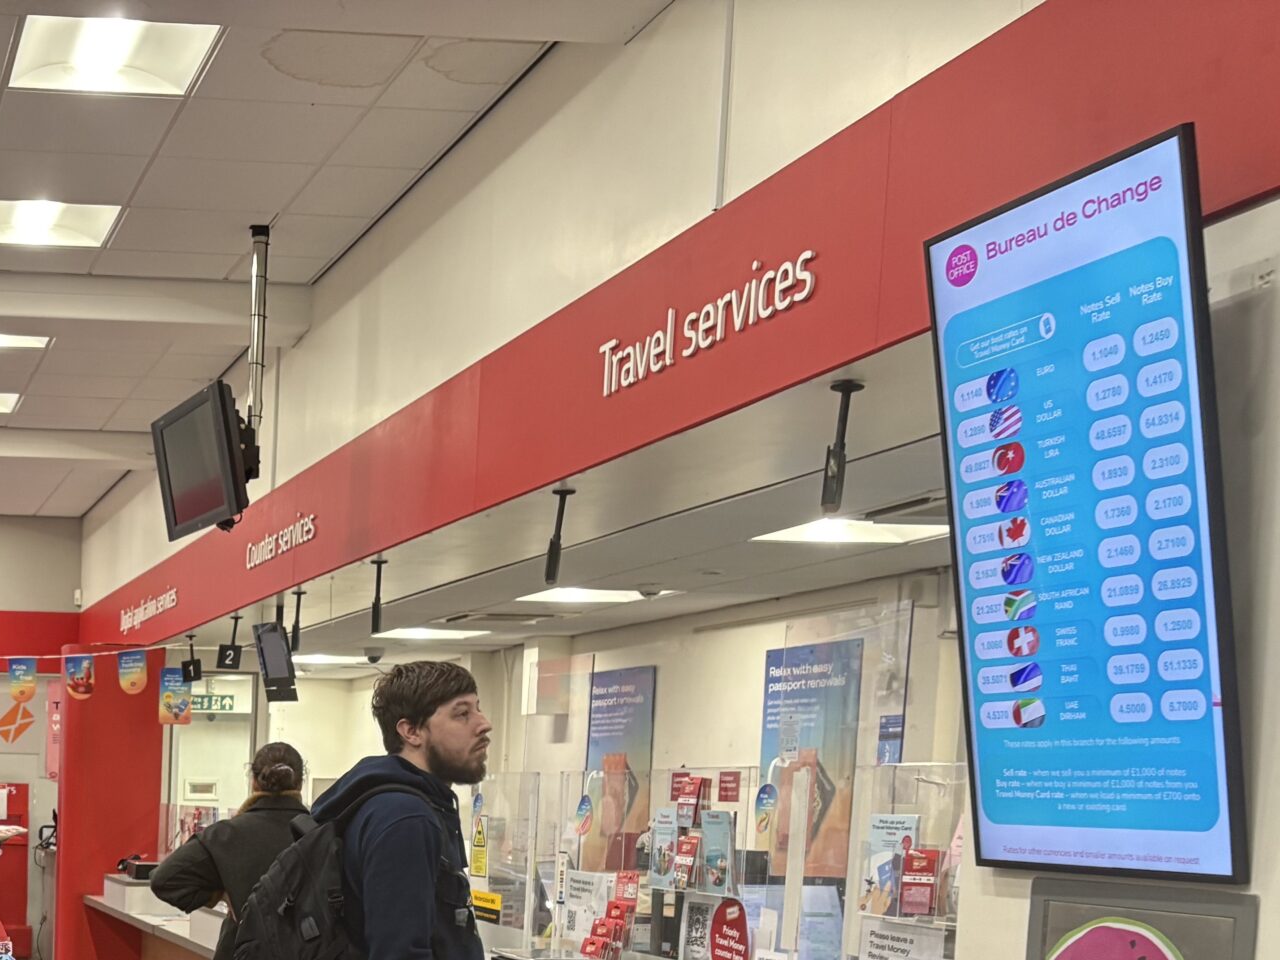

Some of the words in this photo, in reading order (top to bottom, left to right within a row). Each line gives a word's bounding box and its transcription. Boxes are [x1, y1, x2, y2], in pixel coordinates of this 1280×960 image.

[986, 222, 1048, 260] Bureau
[1053, 211, 1078, 233] de
[1081, 175, 1163, 219] Change
[951, 250, 971, 268] POST
[948, 262, 975, 281] OFFICE
[1129, 281, 1154, 297] Notes
[1156, 276, 1174, 289] Buy
[1080, 300, 1104, 316] Notes
[1105, 292, 1121, 307] Sell
[1142, 292, 1163, 306] Rate
[599, 307, 676, 397] Travel
[682, 249, 816, 357] services
[1091, 310, 1111, 324] Rate
[1141, 328, 1171, 346] 1.2450
[1036, 364, 1055, 376] EURO
[1145, 371, 1175, 388] 1.4170
[1043, 399, 1054, 409] US
[1035, 409, 1062, 423] DOLLAR
[1037, 435, 1066, 448] TURKISH
[1044, 448, 1060, 459] LIRA
[1151, 454, 1181, 470] 2.3100
[1034, 473, 1076, 489] AUSTRALIAN
[1042, 486, 1068, 500] DOLLAR
[1154, 496, 1184, 511] 2.1700
[1040, 512, 1075, 526] CANADIAN
[1045, 524, 1072, 537] DOLLAR
[246, 533, 278, 570] Counter
[278, 512, 316, 554] services
[1157, 536, 1188, 551] 2.7100
[1036, 554, 1053, 564] NEW
[1053, 549, 1084, 561] ZEALAND
[1048, 562, 1075, 574] DOLLAR
[1038, 591, 1060, 601] SOUTH
[1060, 587, 1090, 598] AFRICAN
[120, 605, 134, 635] Digital
[133, 595, 157, 630] application
[156, 585, 177, 614] services
[1054, 601, 1074, 610] RAND
[1055, 626, 1077, 636] SWISS
[1163, 619, 1193, 632] 1.2500
[1056, 638, 1078, 647] FRANC
[224, 650, 235, 664] 2
[188, 664, 194, 677] 1
[769, 666, 792, 678] Relax
[793, 663, 812, 675] with
[813, 662, 834, 675] easy
[1061, 664, 1077, 673] THAI
[1163, 659, 1198, 671] 51.1335
[1060, 675, 1079, 684] BAHT
[768, 680, 806, 694] passport
[1065, 701, 1079, 709] UAE
[1119, 702, 1146, 714] 4.5000
[1169, 700, 1198, 712] 5.7000
[1060, 711, 1086, 720] DIRHAM
[722, 924, 740, 941] Priority
[869, 930, 890, 941] Please
[890, 934, 908, 943] leave
[715, 933, 729, 947] Travel
[729, 938, 746, 955] Money
[869, 940, 887, 951] Travel
[887, 944, 911, 957] Money
[714, 948, 732, 959] counter
